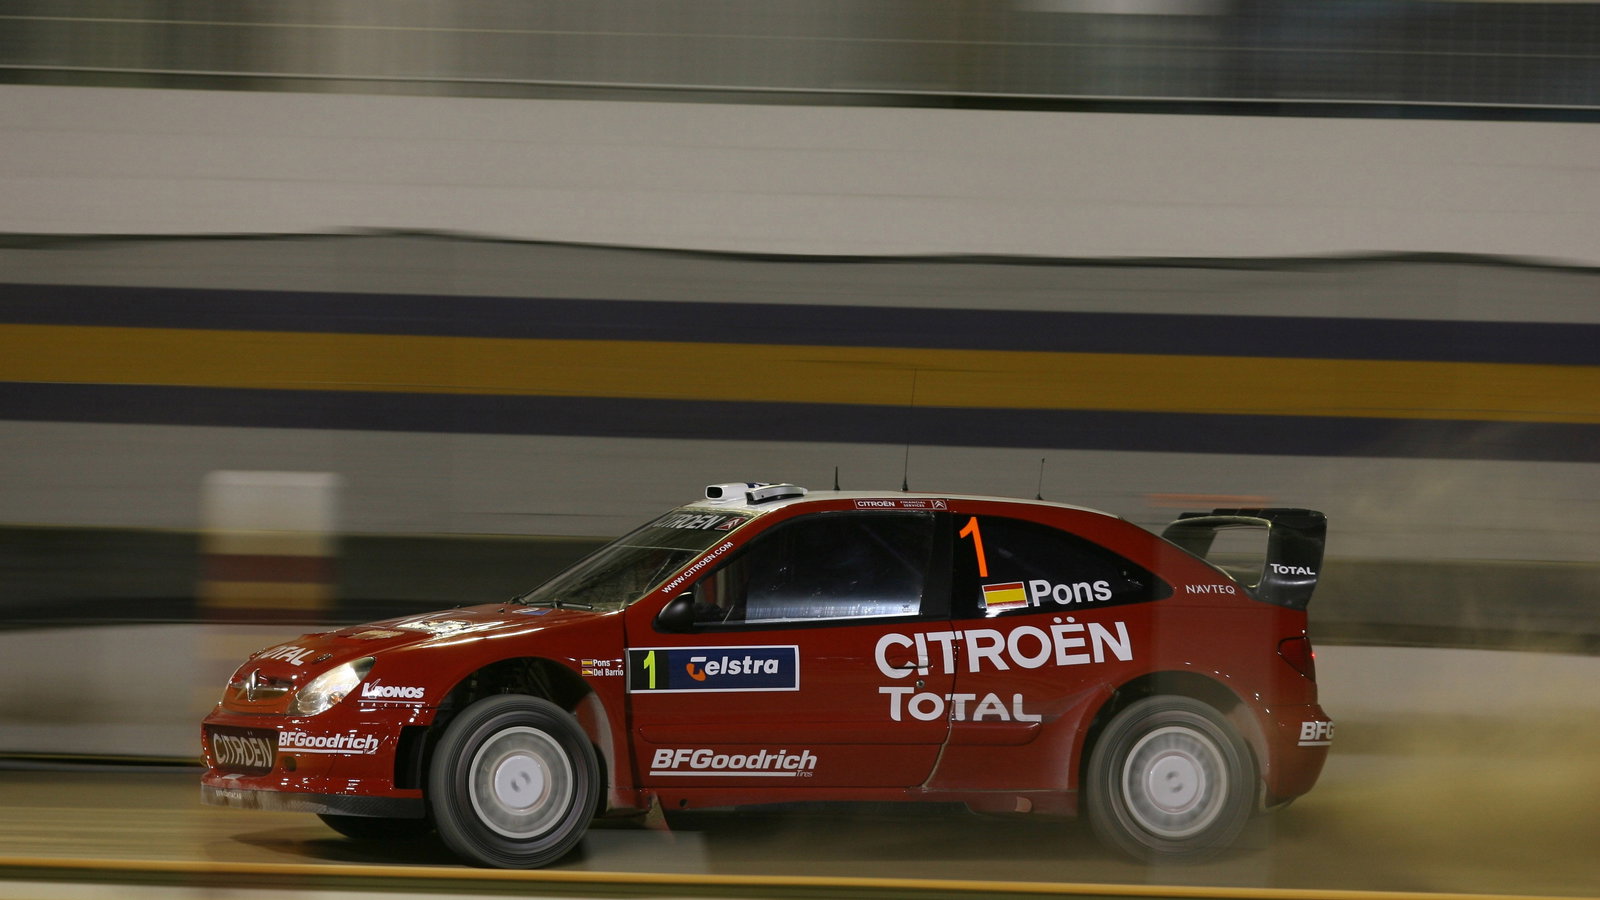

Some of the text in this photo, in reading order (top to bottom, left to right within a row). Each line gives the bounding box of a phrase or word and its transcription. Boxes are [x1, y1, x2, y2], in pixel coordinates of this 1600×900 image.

[959, 516, 988, 577] 1
[661, 541, 734, 594] WWW.CITROEN.COM
[1270, 563, 1315, 576] TOTAL
[1029, 579, 1112, 607] Pons
[1185, 584, 1235, 595] NAVTEQ
[874, 616, 1133, 679] CITROËN
[593, 659, 611, 667] Pons
[643, 650, 656, 689] 1
[686, 656, 779, 682] Telstra
[361, 679, 425, 699] KRONOS
[878, 686, 1042, 723] TOTAL
[278, 732, 379, 750] BFGoodrich
[651, 749, 818, 770] BFGoodrich
[796, 770, 813, 778] Tires
